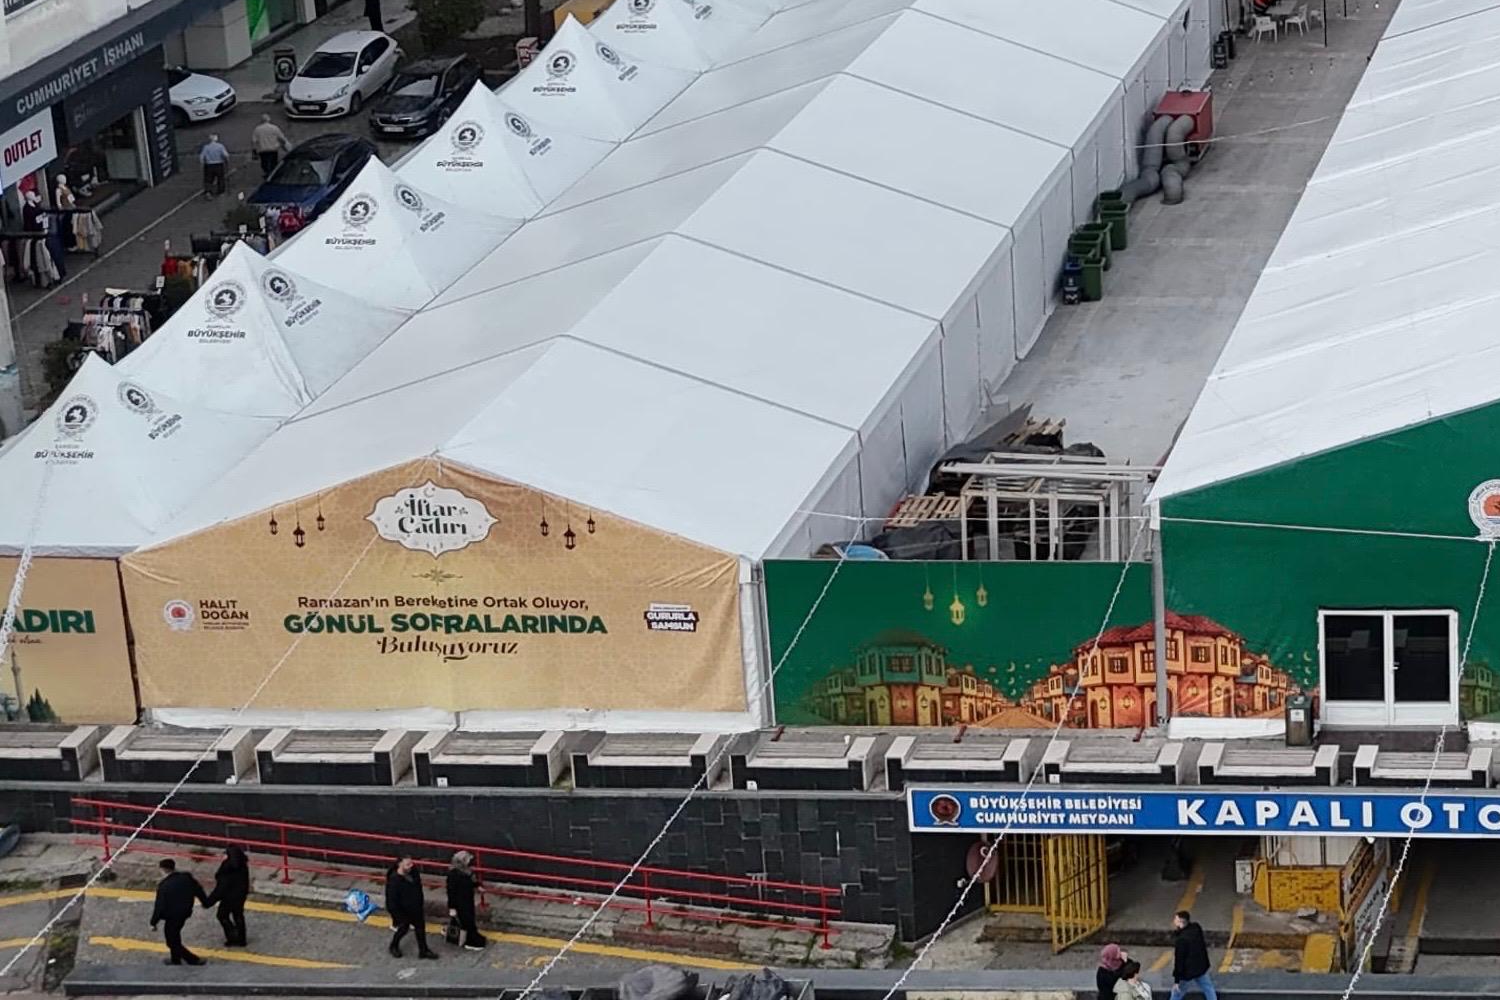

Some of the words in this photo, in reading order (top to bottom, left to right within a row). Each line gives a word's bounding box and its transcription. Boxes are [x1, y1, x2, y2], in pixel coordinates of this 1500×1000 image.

[16, 58, 99, 114] CUMHURİYET
[103, 31, 144, 67] İŞHANI
[4, 129, 43, 167] OUTLET
[187, 328, 247, 339] BÜYÜKŞEHİR
[34, 450, 95, 460] BÜÜKŞEHİR
[394, 595, 478, 609] Bereketine
[483, 596, 528, 608] Ortak
[532, 596, 589, 610] Oluyor,
[283, 611, 385, 634] GÖNÜL
[391, 612, 608, 634] SOFRALARINDA
[376, 634, 519, 663] Buluşuyoruz
[969, 794, 1061, 812] BÜYÜKŞEHİR
[1064, 795, 1142, 811] BELEDİYESİ
[975, 809, 1066, 825] CUMHURİYET
[1069, 812, 1134, 826] MEYDANI
[1178, 799, 1374, 828] KAPALI
